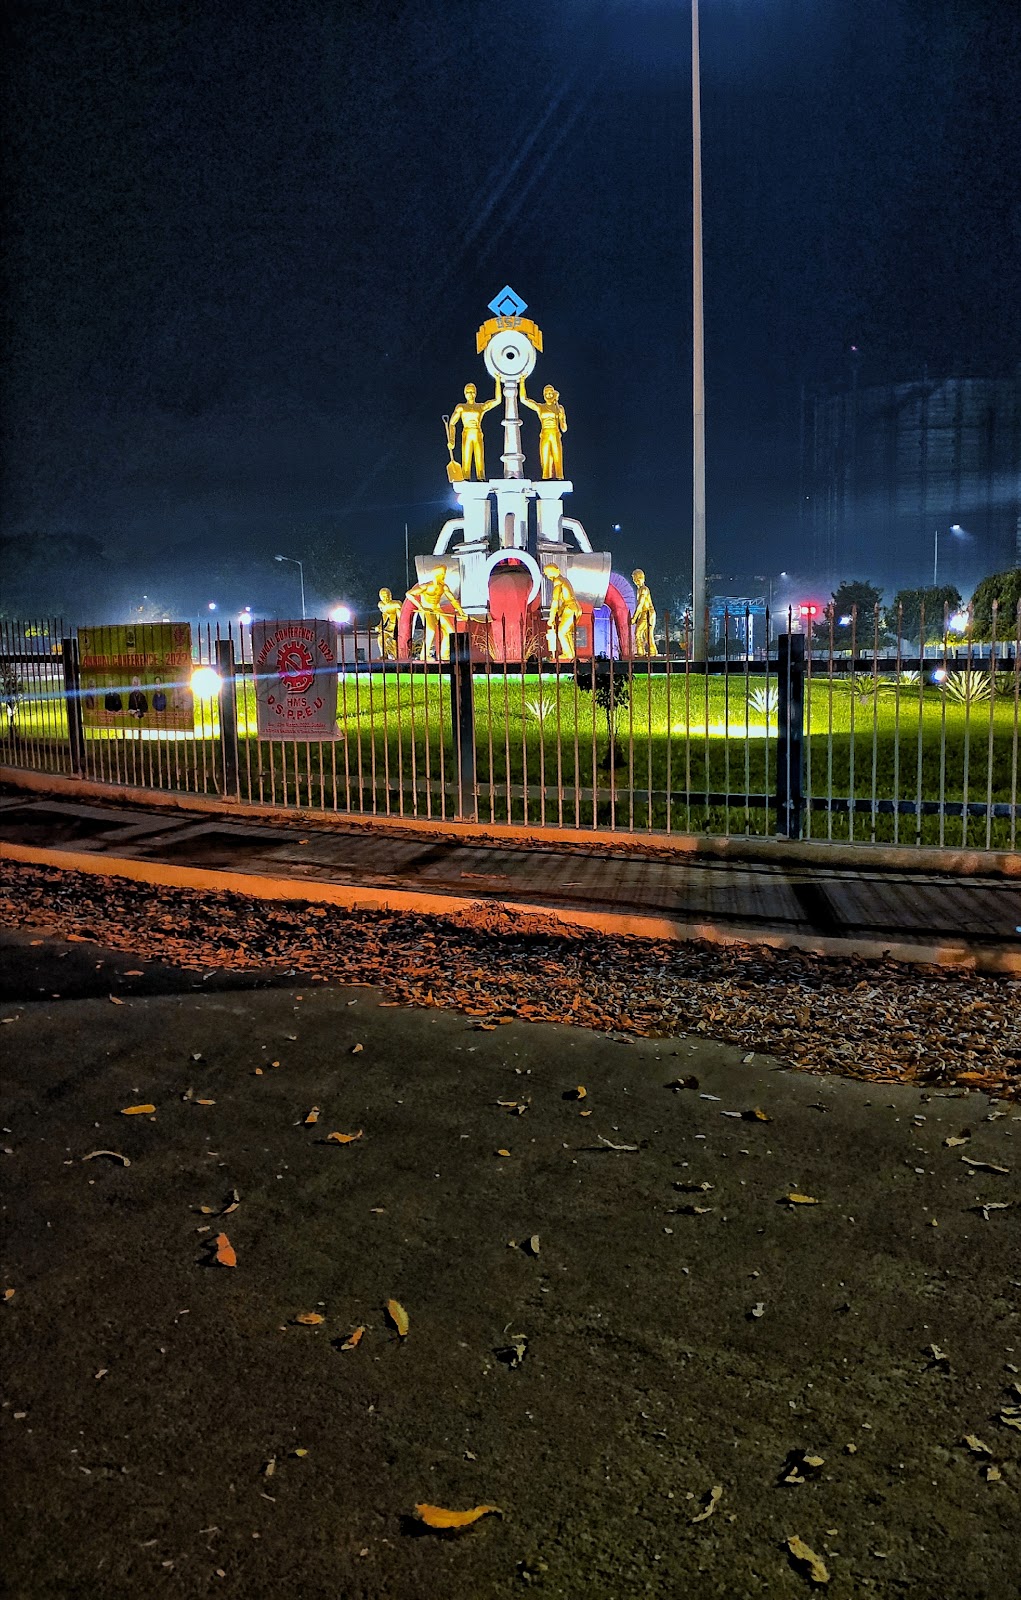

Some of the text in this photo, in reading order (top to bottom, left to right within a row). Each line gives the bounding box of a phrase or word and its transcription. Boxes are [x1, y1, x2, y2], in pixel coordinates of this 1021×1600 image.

[496, 316, 522, 328] DSP
[257, 626, 335, 666] ANNUAL CONFERENCE 2022
[82, 652, 188, 667] ANNUAL CONFERENCE 2022
[287, 698, 307, 707] HMS
